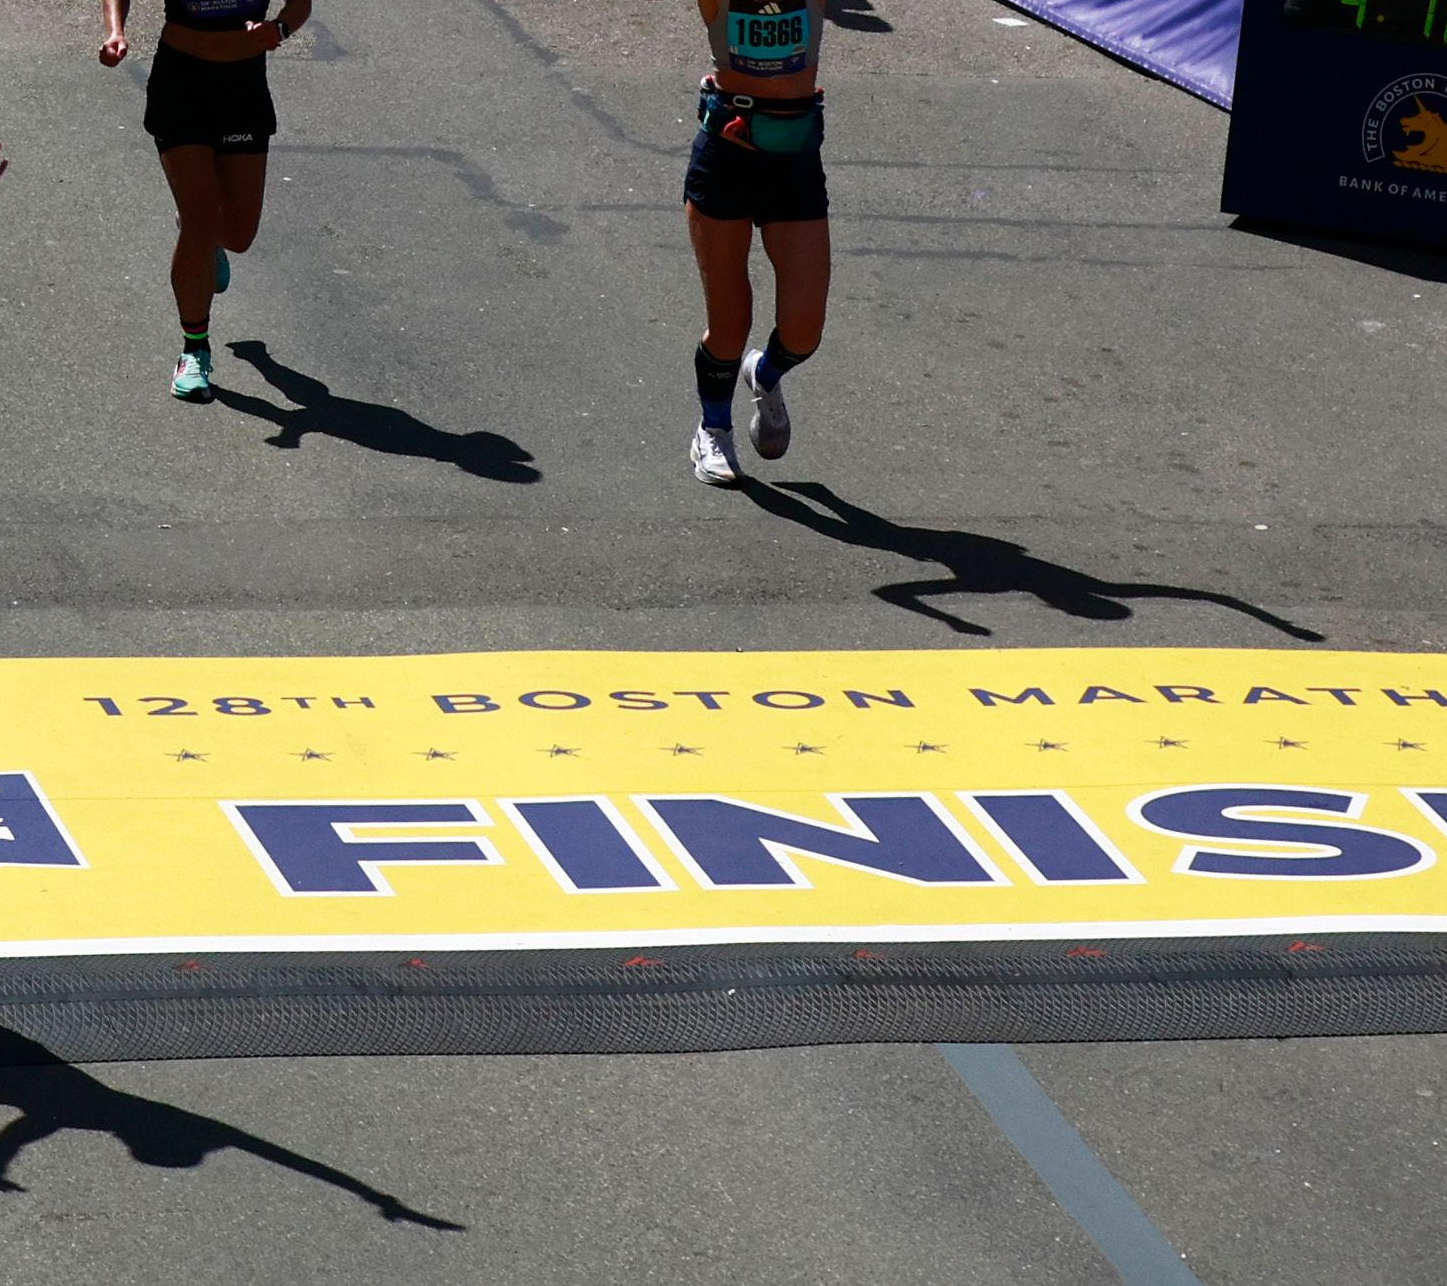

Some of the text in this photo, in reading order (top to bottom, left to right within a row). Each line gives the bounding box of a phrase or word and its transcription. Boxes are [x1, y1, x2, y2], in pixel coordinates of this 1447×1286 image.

[1367, 110, 1381, 153] THE
[1379, 77, 1437, 115] BOSTON
[1338, 175, 1385, 196] BANK
[1388, 181, 1409, 199] OF
[84, 693, 377, 717] 128TH
[431, 687, 918, 715] BOSTON
